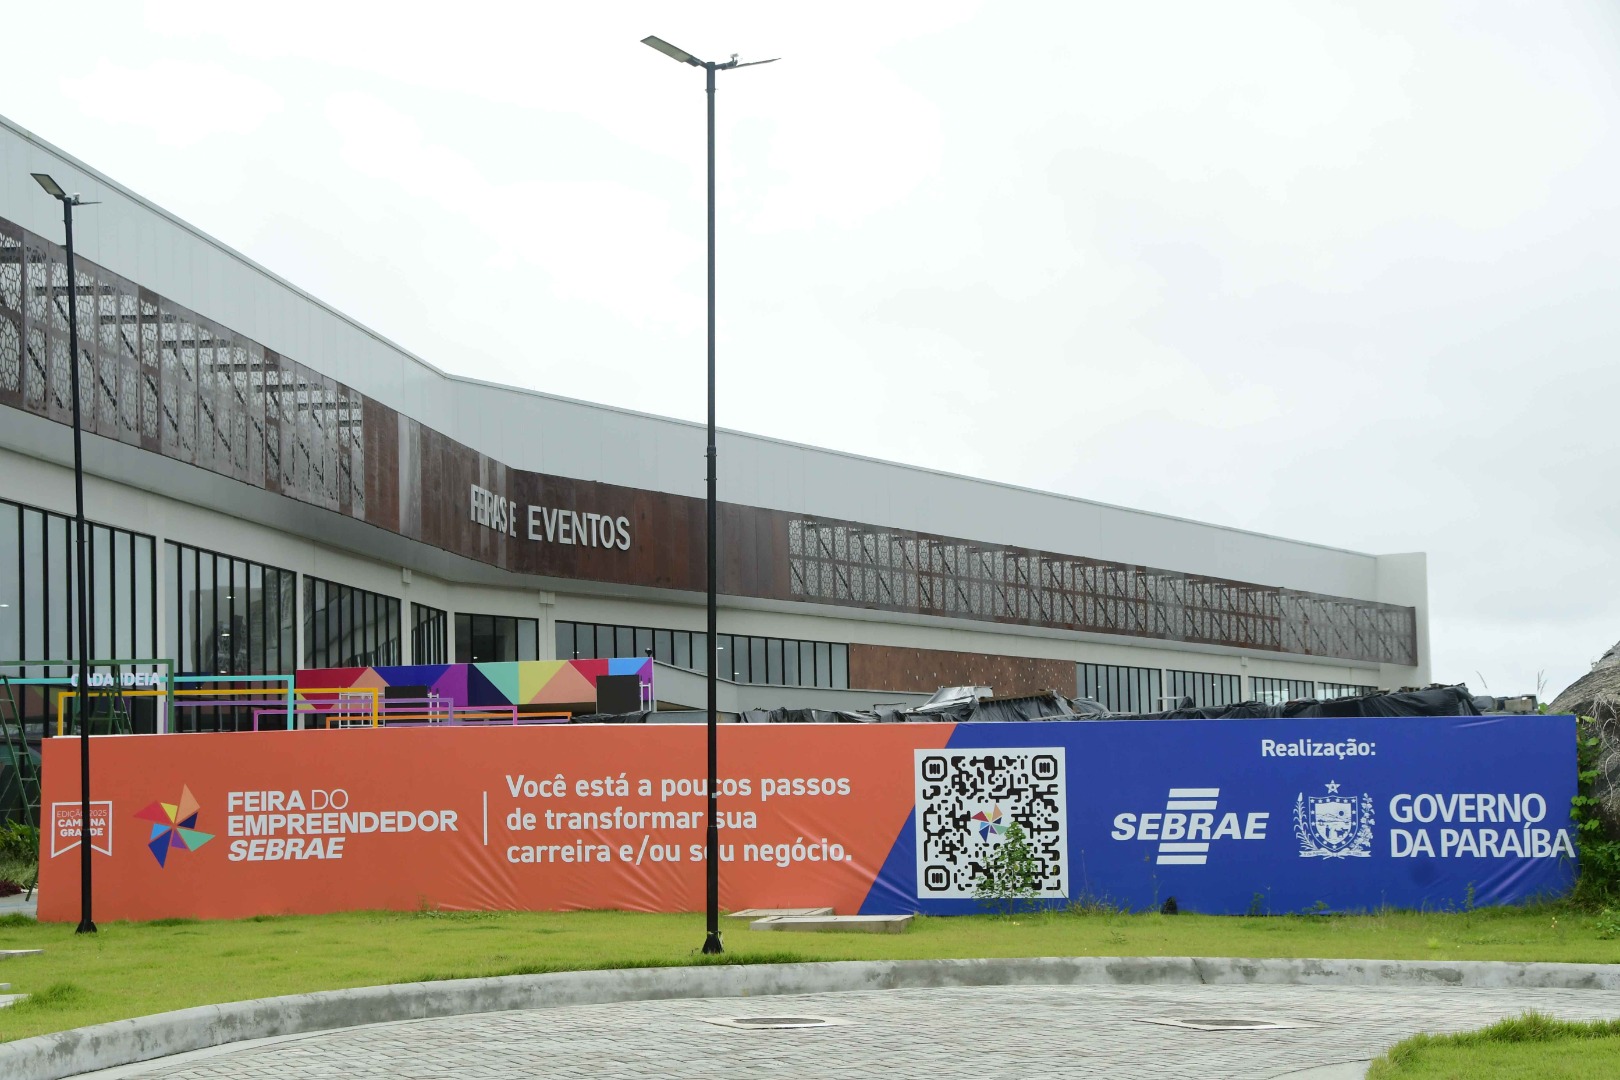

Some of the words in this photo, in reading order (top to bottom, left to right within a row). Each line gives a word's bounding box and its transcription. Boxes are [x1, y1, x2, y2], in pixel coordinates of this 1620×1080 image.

[510, 501, 516, 538] E
[528, 504, 631, 551] EVENTOS
[120, 672, 160, 686] IDEIA
[1261, 738, 1376, 760] Realização:
[506, 774, 567, 797] Você
[576, 773, 628, 797] está
[638, 779, 652, 797] a
[761, 778, 851, 802] passos
[228, 790, 305, 812] FEIRA
[311, 788, 349, 810] DO
[1390, 793, 1547, 823] GOVERNO
[57, 809, 83, 819] EDIÇÃ
[90, 809, 107, 818] 2025
[58, 818, 106, 828] CAMNA
[228, 810, 458, 836] EMPREENDEDOR
[507, 808, 536, 830] de
[545, 806, 704, 830] transformar
[716, 811, 757, 829] sua
[60, 828, 104, 837] GRADE
[1111, 812, 1270, 841] SEBRAE
[228, 837, 345, 861] SEBRAE
[507, 839, 611, 864] carreira
[619, 835, 681, 866] e/ou
[690, 844, 735, 862] su
[744, 837, 853, 868] negócio.
[1391, 829, 1436, 858] DA
[1441, 822, 1576, 858] PARAÍBA
